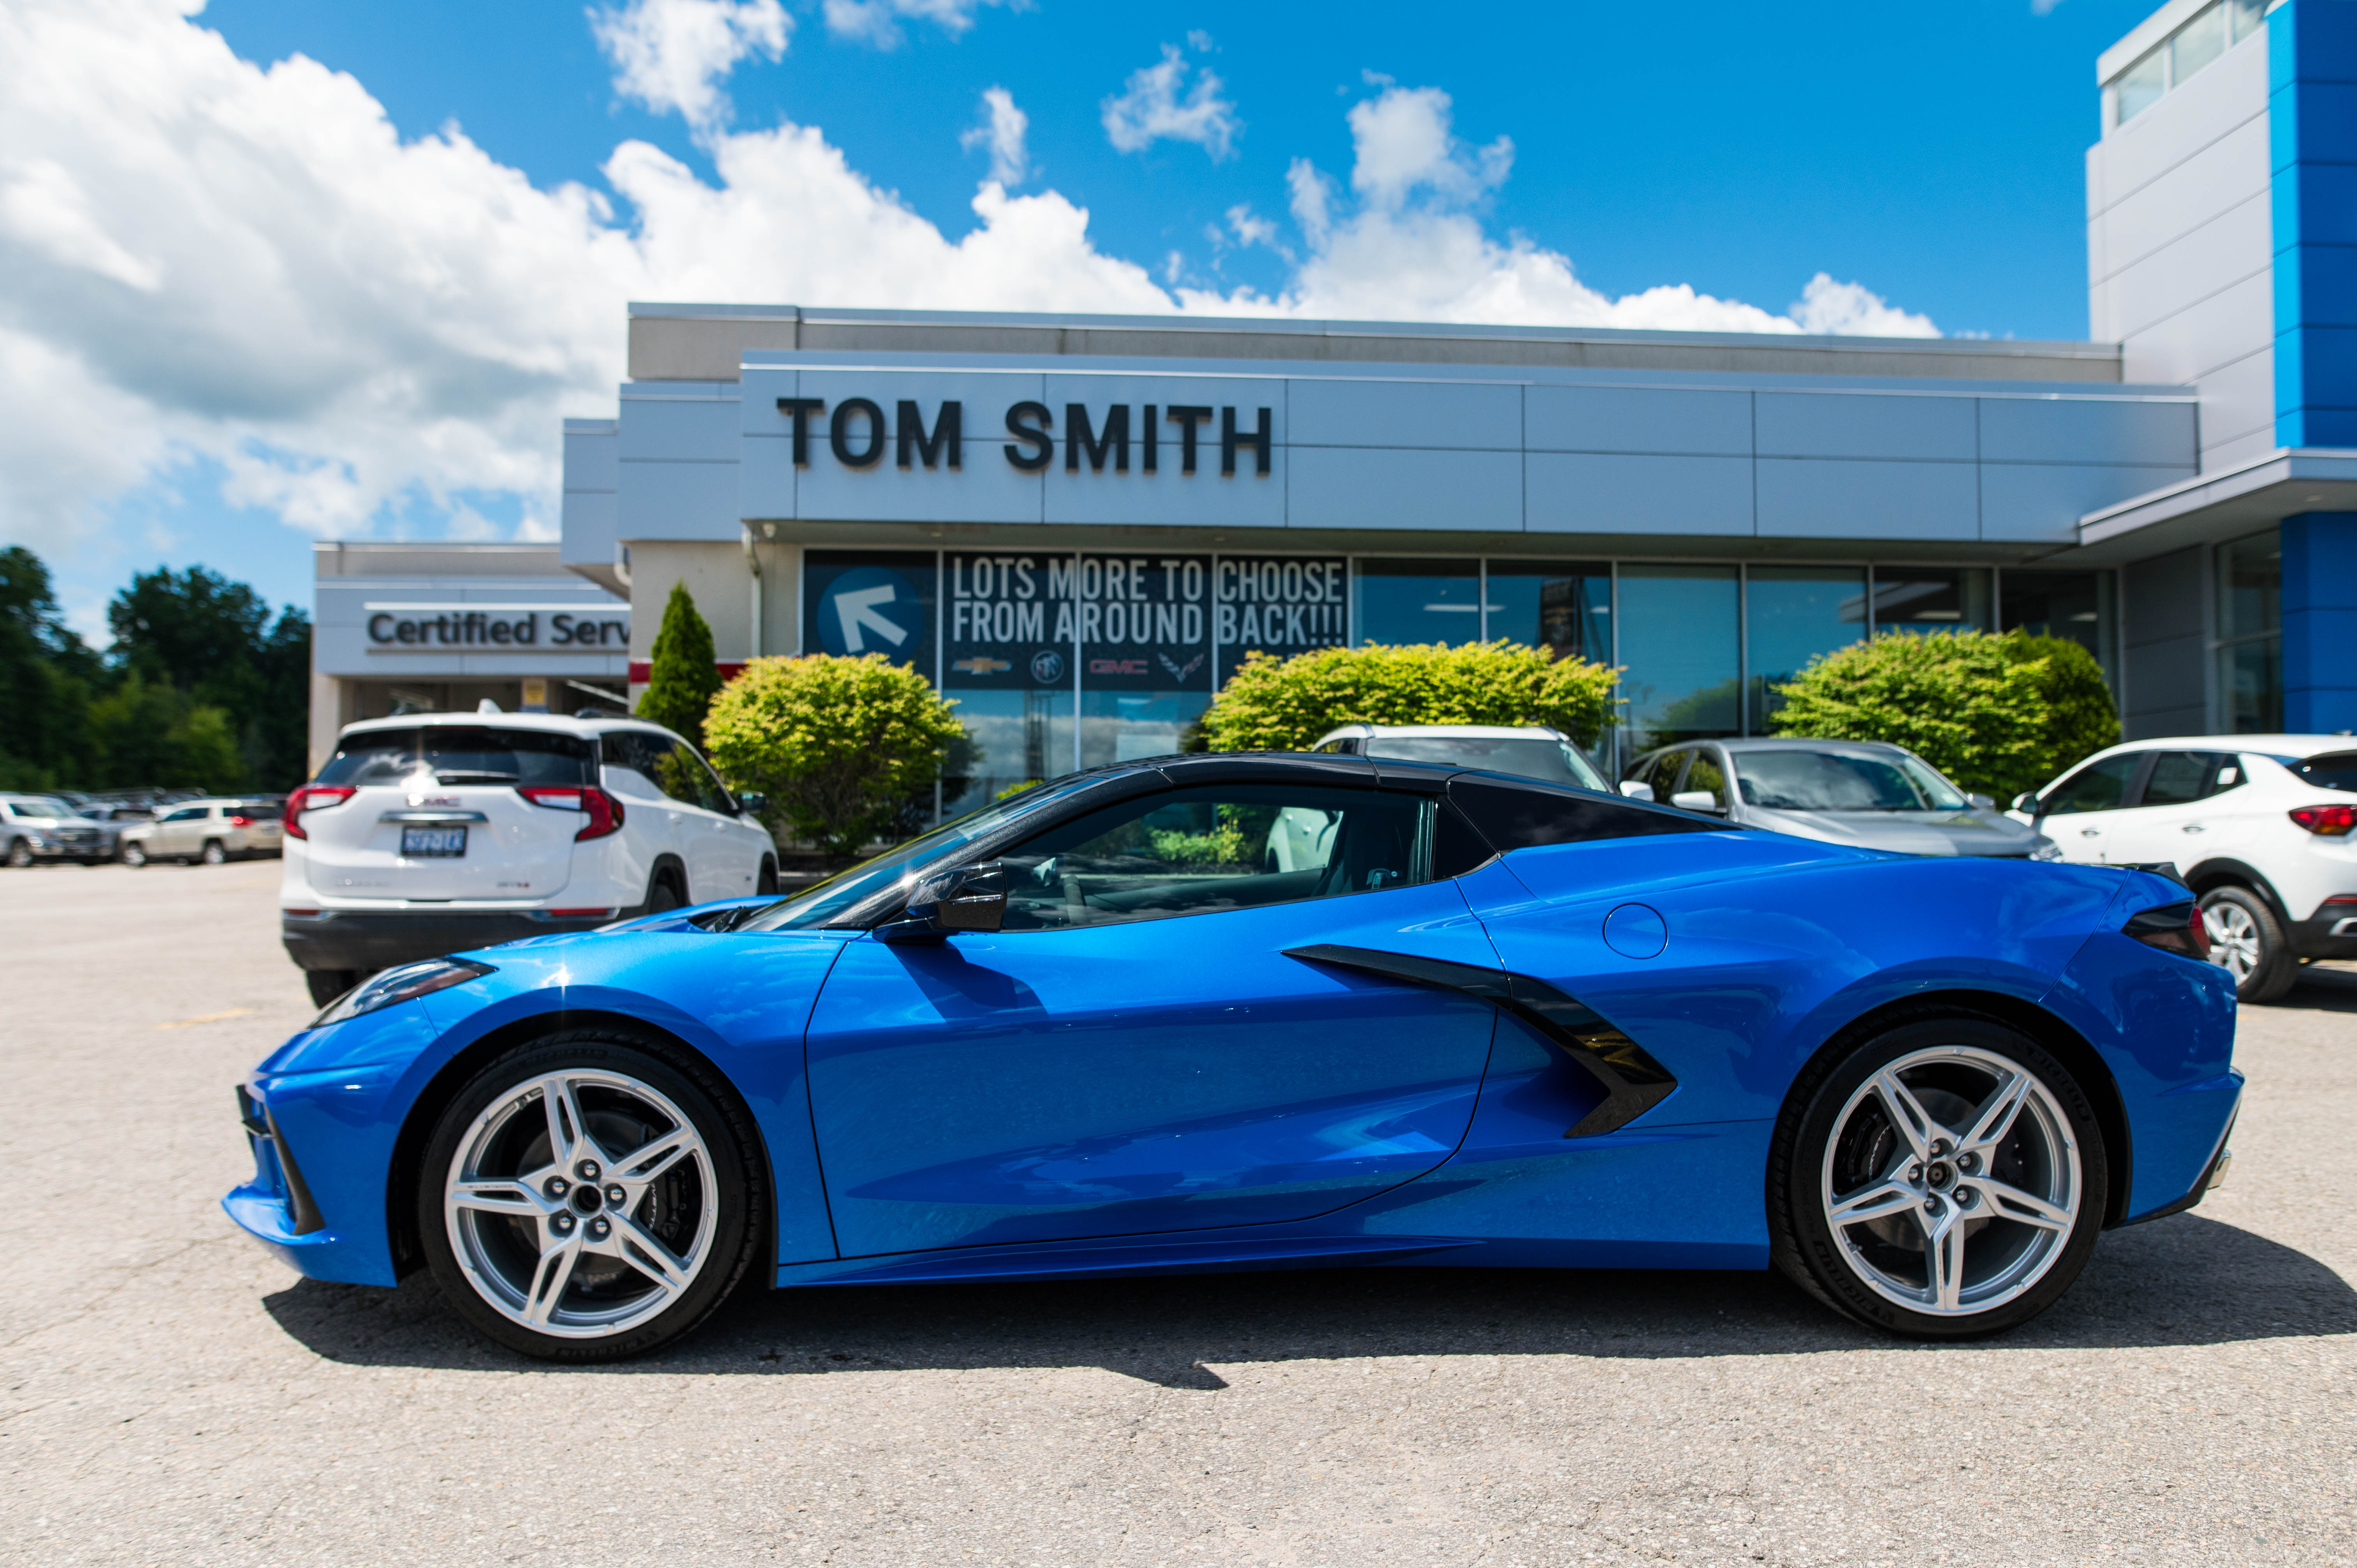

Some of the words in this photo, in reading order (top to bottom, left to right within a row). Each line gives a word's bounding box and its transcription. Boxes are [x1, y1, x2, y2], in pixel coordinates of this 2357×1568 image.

[777, 397, 962, 469] TOM
[1004, 401, 1271, 477] SMITH
[954, 557, 1036, 600] LOTS
[1048, 558, 1148, 601] MORE
[1160, 560, 1203, 602] TO
[1218, 560, 1343, 603] CHOOSE
[368, 612, 537, 645] Certified
[954, 600, 1044, 643] FROM
[1053, 601, 1203, 645] AROUND
[1217, 604, 1343, 646] BACK!!!
[1090, 659, 1148, 674] GMC
[1815, 1244, 1873, 1310] MICHELIN
